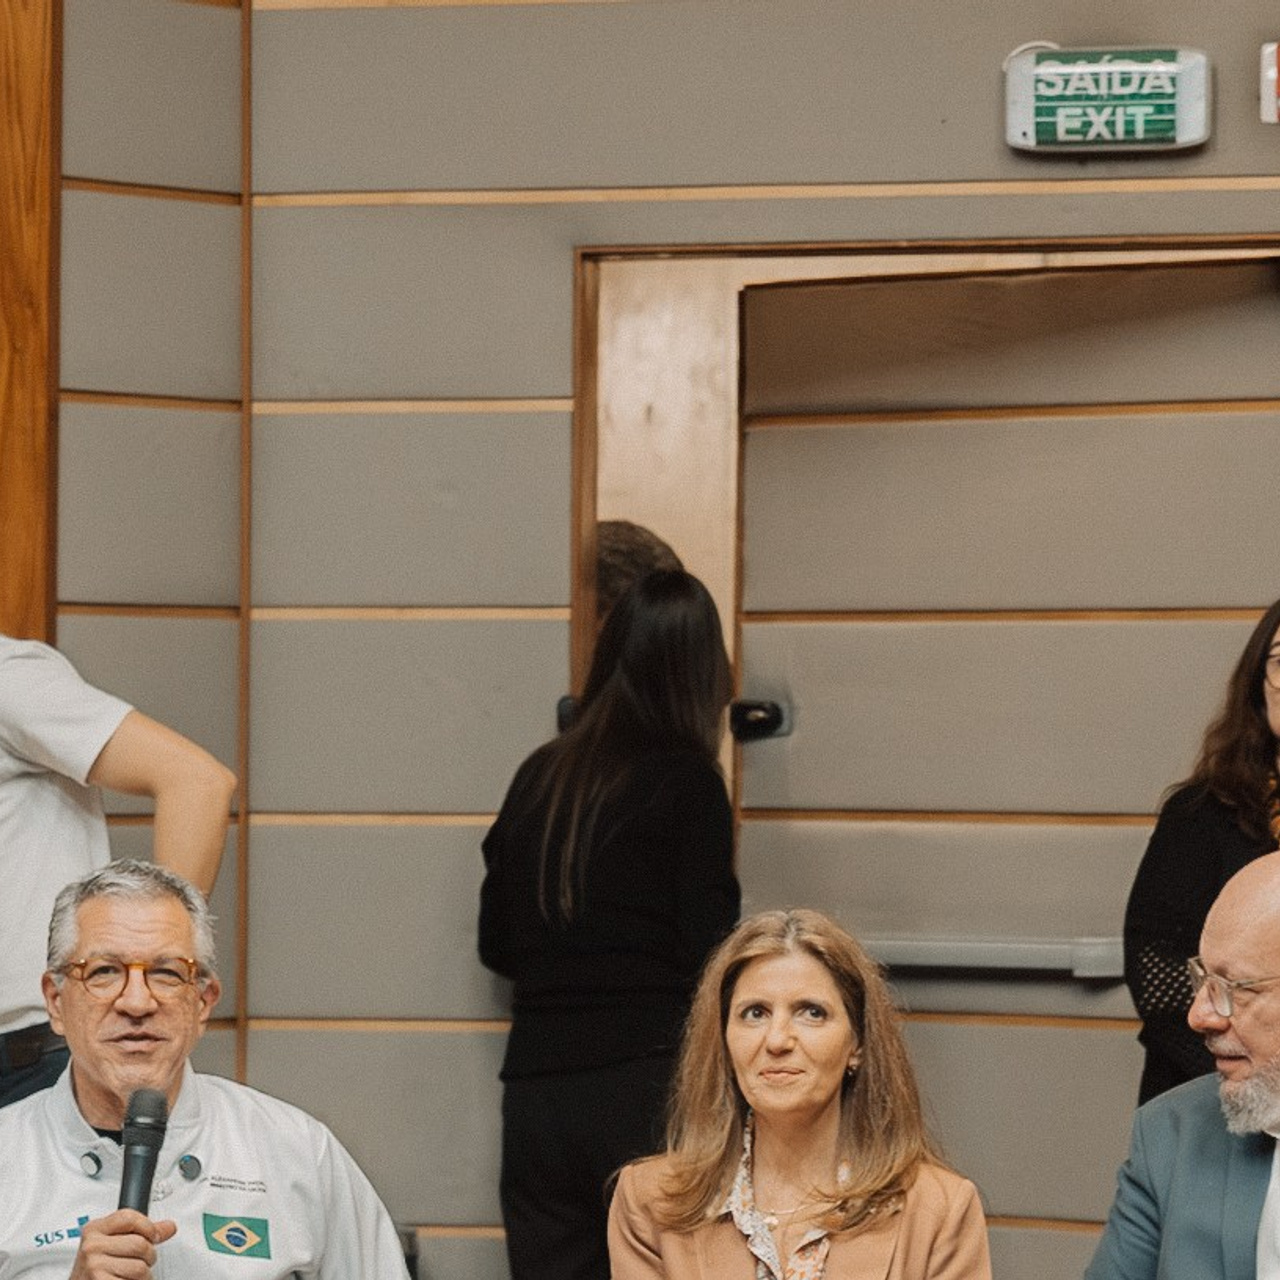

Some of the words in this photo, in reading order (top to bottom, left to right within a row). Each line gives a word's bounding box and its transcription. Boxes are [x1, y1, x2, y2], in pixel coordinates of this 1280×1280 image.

[1036, 55, 1177, 96] SAÍDA
[1056, 106, 1155, 141] EXIT
[34, 1229, 64, 1248] SUS
